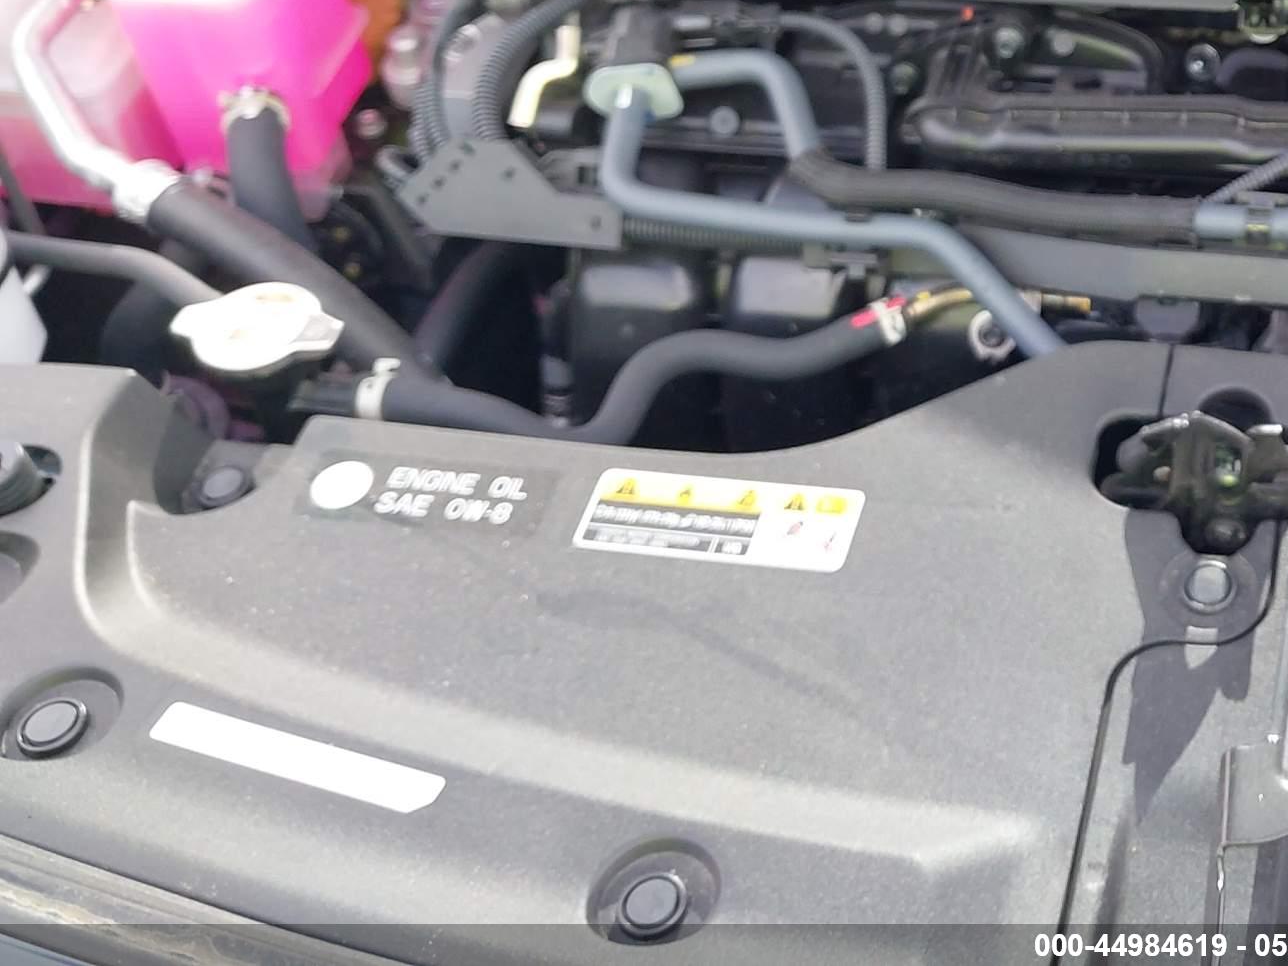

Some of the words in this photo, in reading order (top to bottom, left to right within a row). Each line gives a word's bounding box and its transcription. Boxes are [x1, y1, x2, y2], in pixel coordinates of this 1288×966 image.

[385, 466, 481, 495] ENGINE
[488, 476, 528, 500] OIL
[374, 491, 435, 517] SAE
